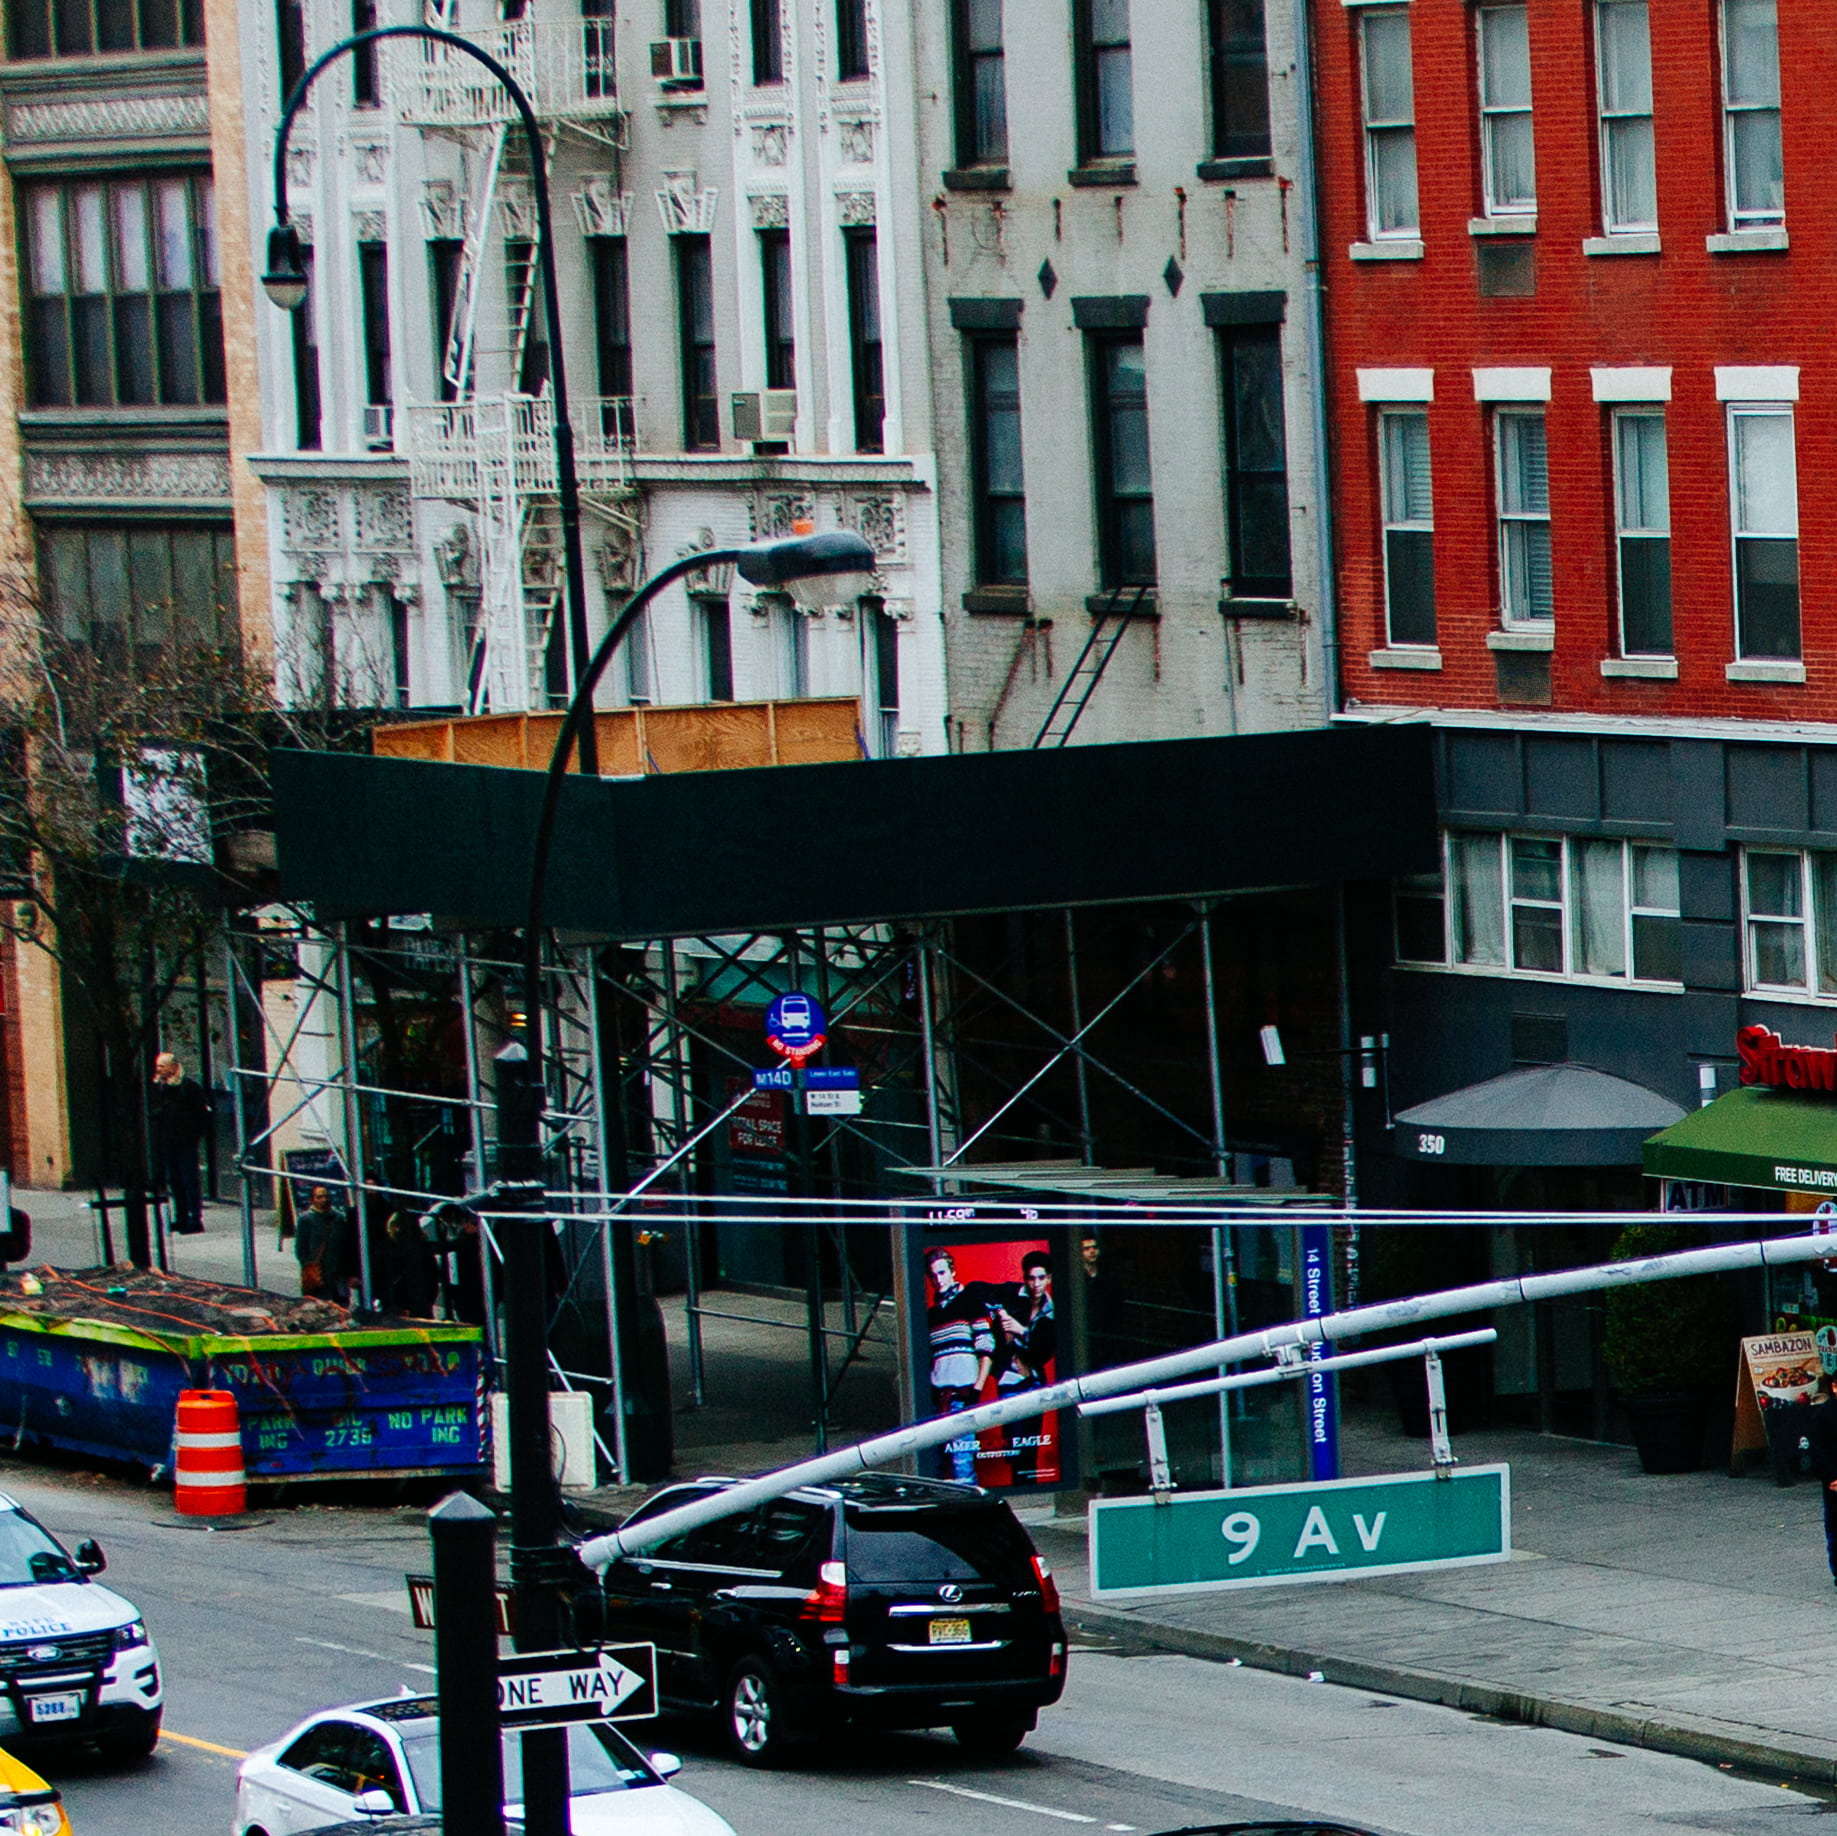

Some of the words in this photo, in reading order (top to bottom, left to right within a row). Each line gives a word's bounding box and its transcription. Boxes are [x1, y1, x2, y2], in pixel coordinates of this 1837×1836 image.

[771, 1040, 784, 1051] NO
[785, 1039, 823, 1057] STANDING
[756, 1071, 792, 1086] M14D
[733, 1115, 757, 1131] TAIL
[1418, 1133, 1446, 1155] 350
[1775, 1166, 1798, 1182] FREE
[1306, 1267, 1322, 1315] Street
[1750, 1338, 1812, 1356] SAMBAZON
[388, 1411, 413, 1430] NO
[421, 1407, 468, 1426] PARK
[1312, 1399, 1326, 1443] Street
[431, 1425, 461, 1444] ING
[1012, 1434, 1053, 1448] EAGLE
[1221, 1511, 1260, 1566] 9
[1293, 1505, 1388, 1559] Av
[2, 1622, 72, 1638] POLICE
[568, 1669, 626, 1699] WAY
